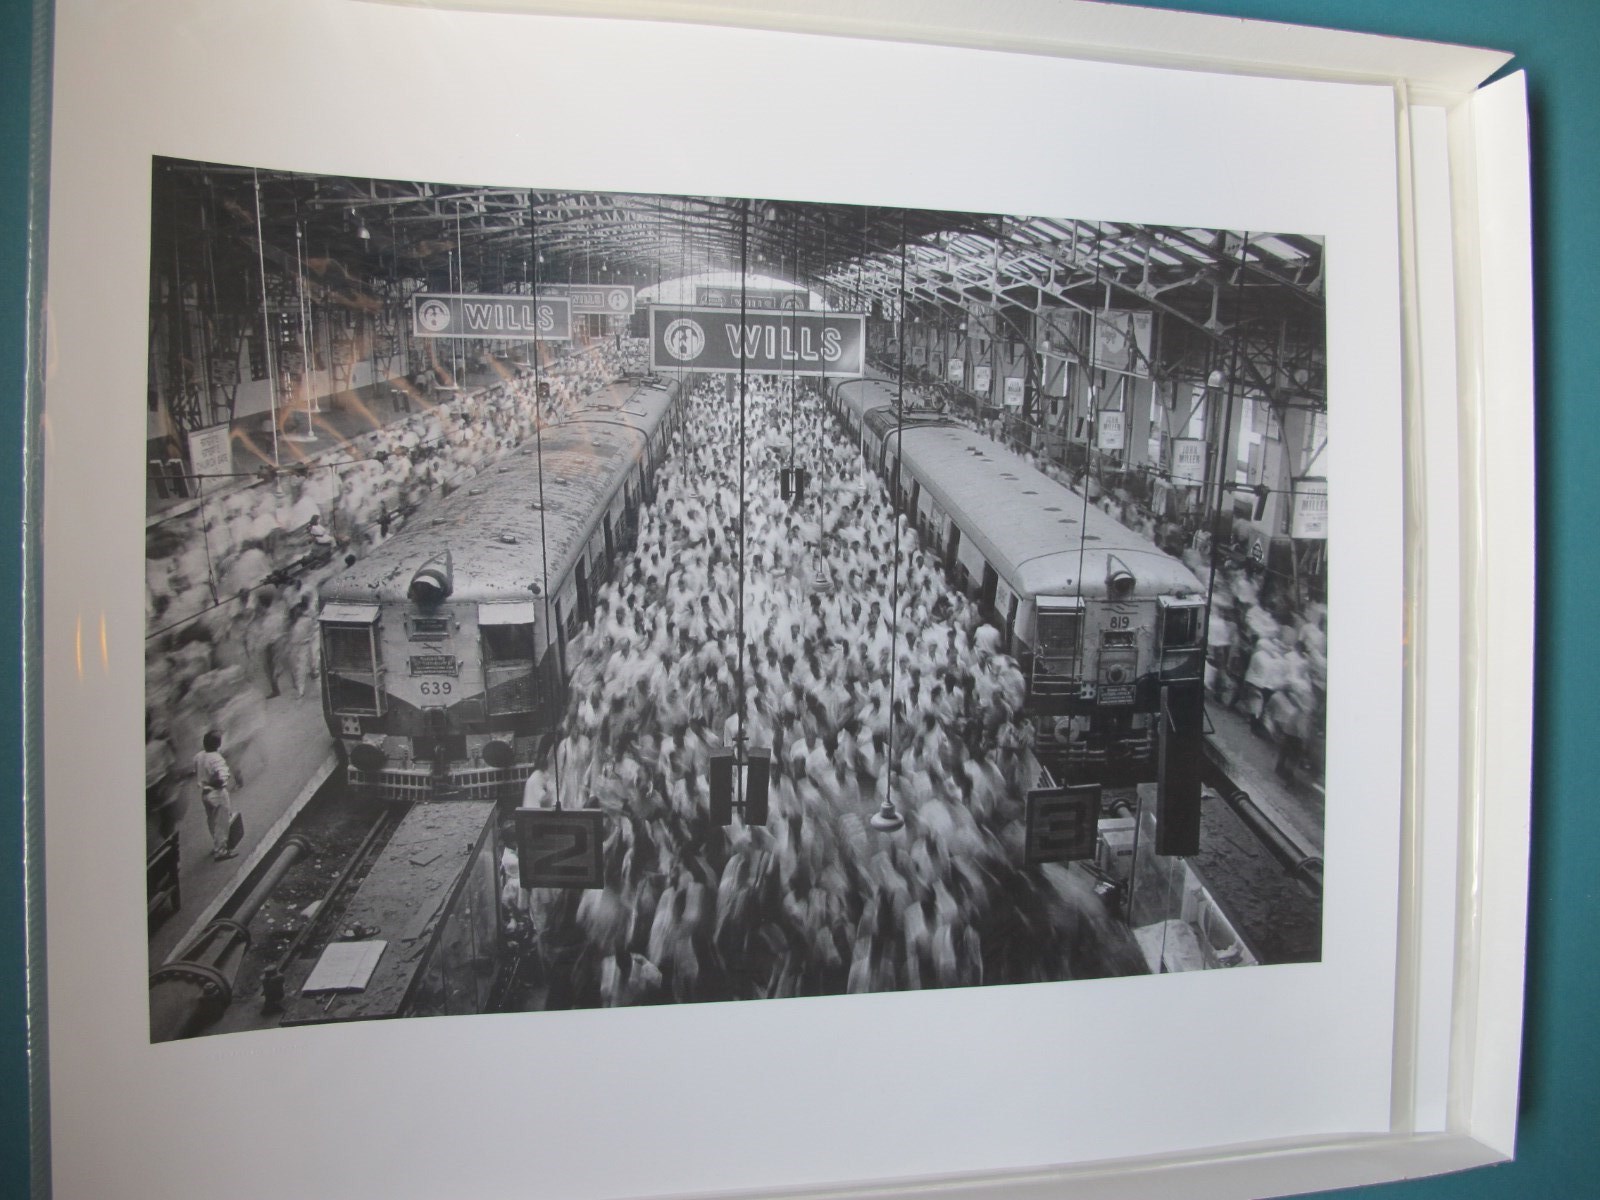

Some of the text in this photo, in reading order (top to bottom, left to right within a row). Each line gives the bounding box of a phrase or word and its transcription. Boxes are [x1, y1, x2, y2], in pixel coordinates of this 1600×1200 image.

[464, 303, 554, 332] WILLS
[725, 323, 842, 362] WILLS
[1103, 423, 1121, 432] MILLER
[1182, 445, 1198, 454] JOHN
[1178, 454, 1201, 464] MILLER
[1109, 616, 1130, 629] 819
[420, 682, 452, 695] 639
[532, 824, 588, 875] 2
